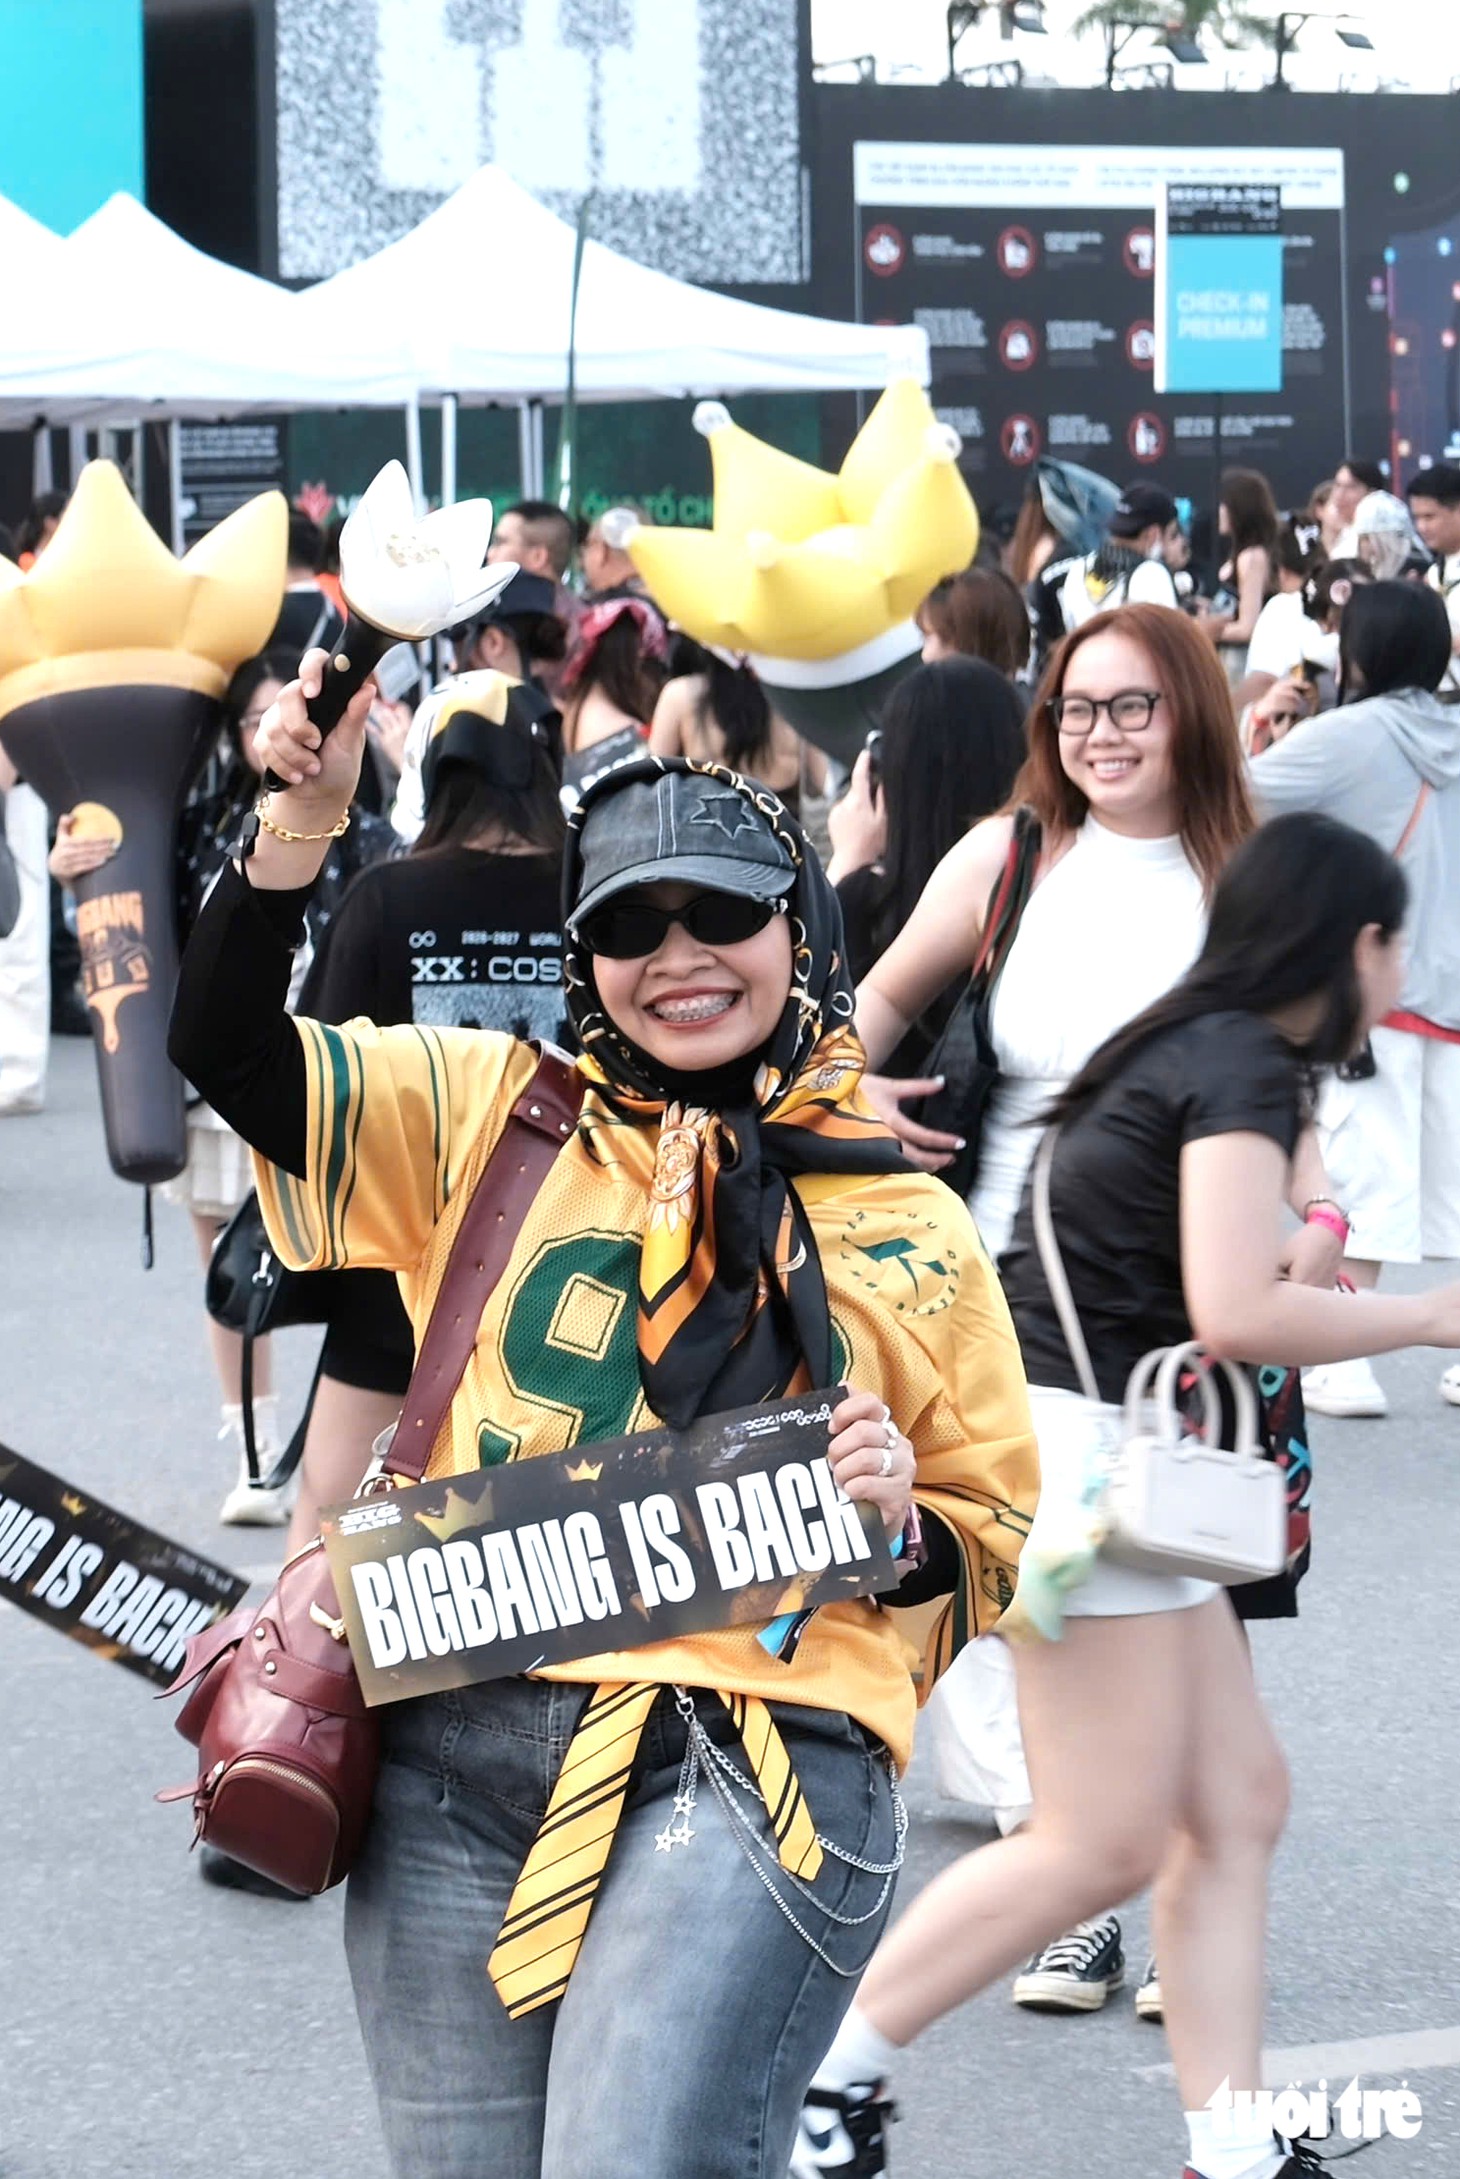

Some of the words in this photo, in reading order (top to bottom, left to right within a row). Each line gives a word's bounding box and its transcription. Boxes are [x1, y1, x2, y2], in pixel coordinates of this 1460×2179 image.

[1177, 291, 1269, 312] CHECK-IN
[1178, 318, 1267, 339] PREMIUM
[350, 1510, 622, 1669] BIGBANG
[620, 1493, 698, 1608] IS
[695, 1457, 872, 1591] BACK
[31, 1534, 104, 1609] IS
[79, 1560, 214, 1673] BACK
